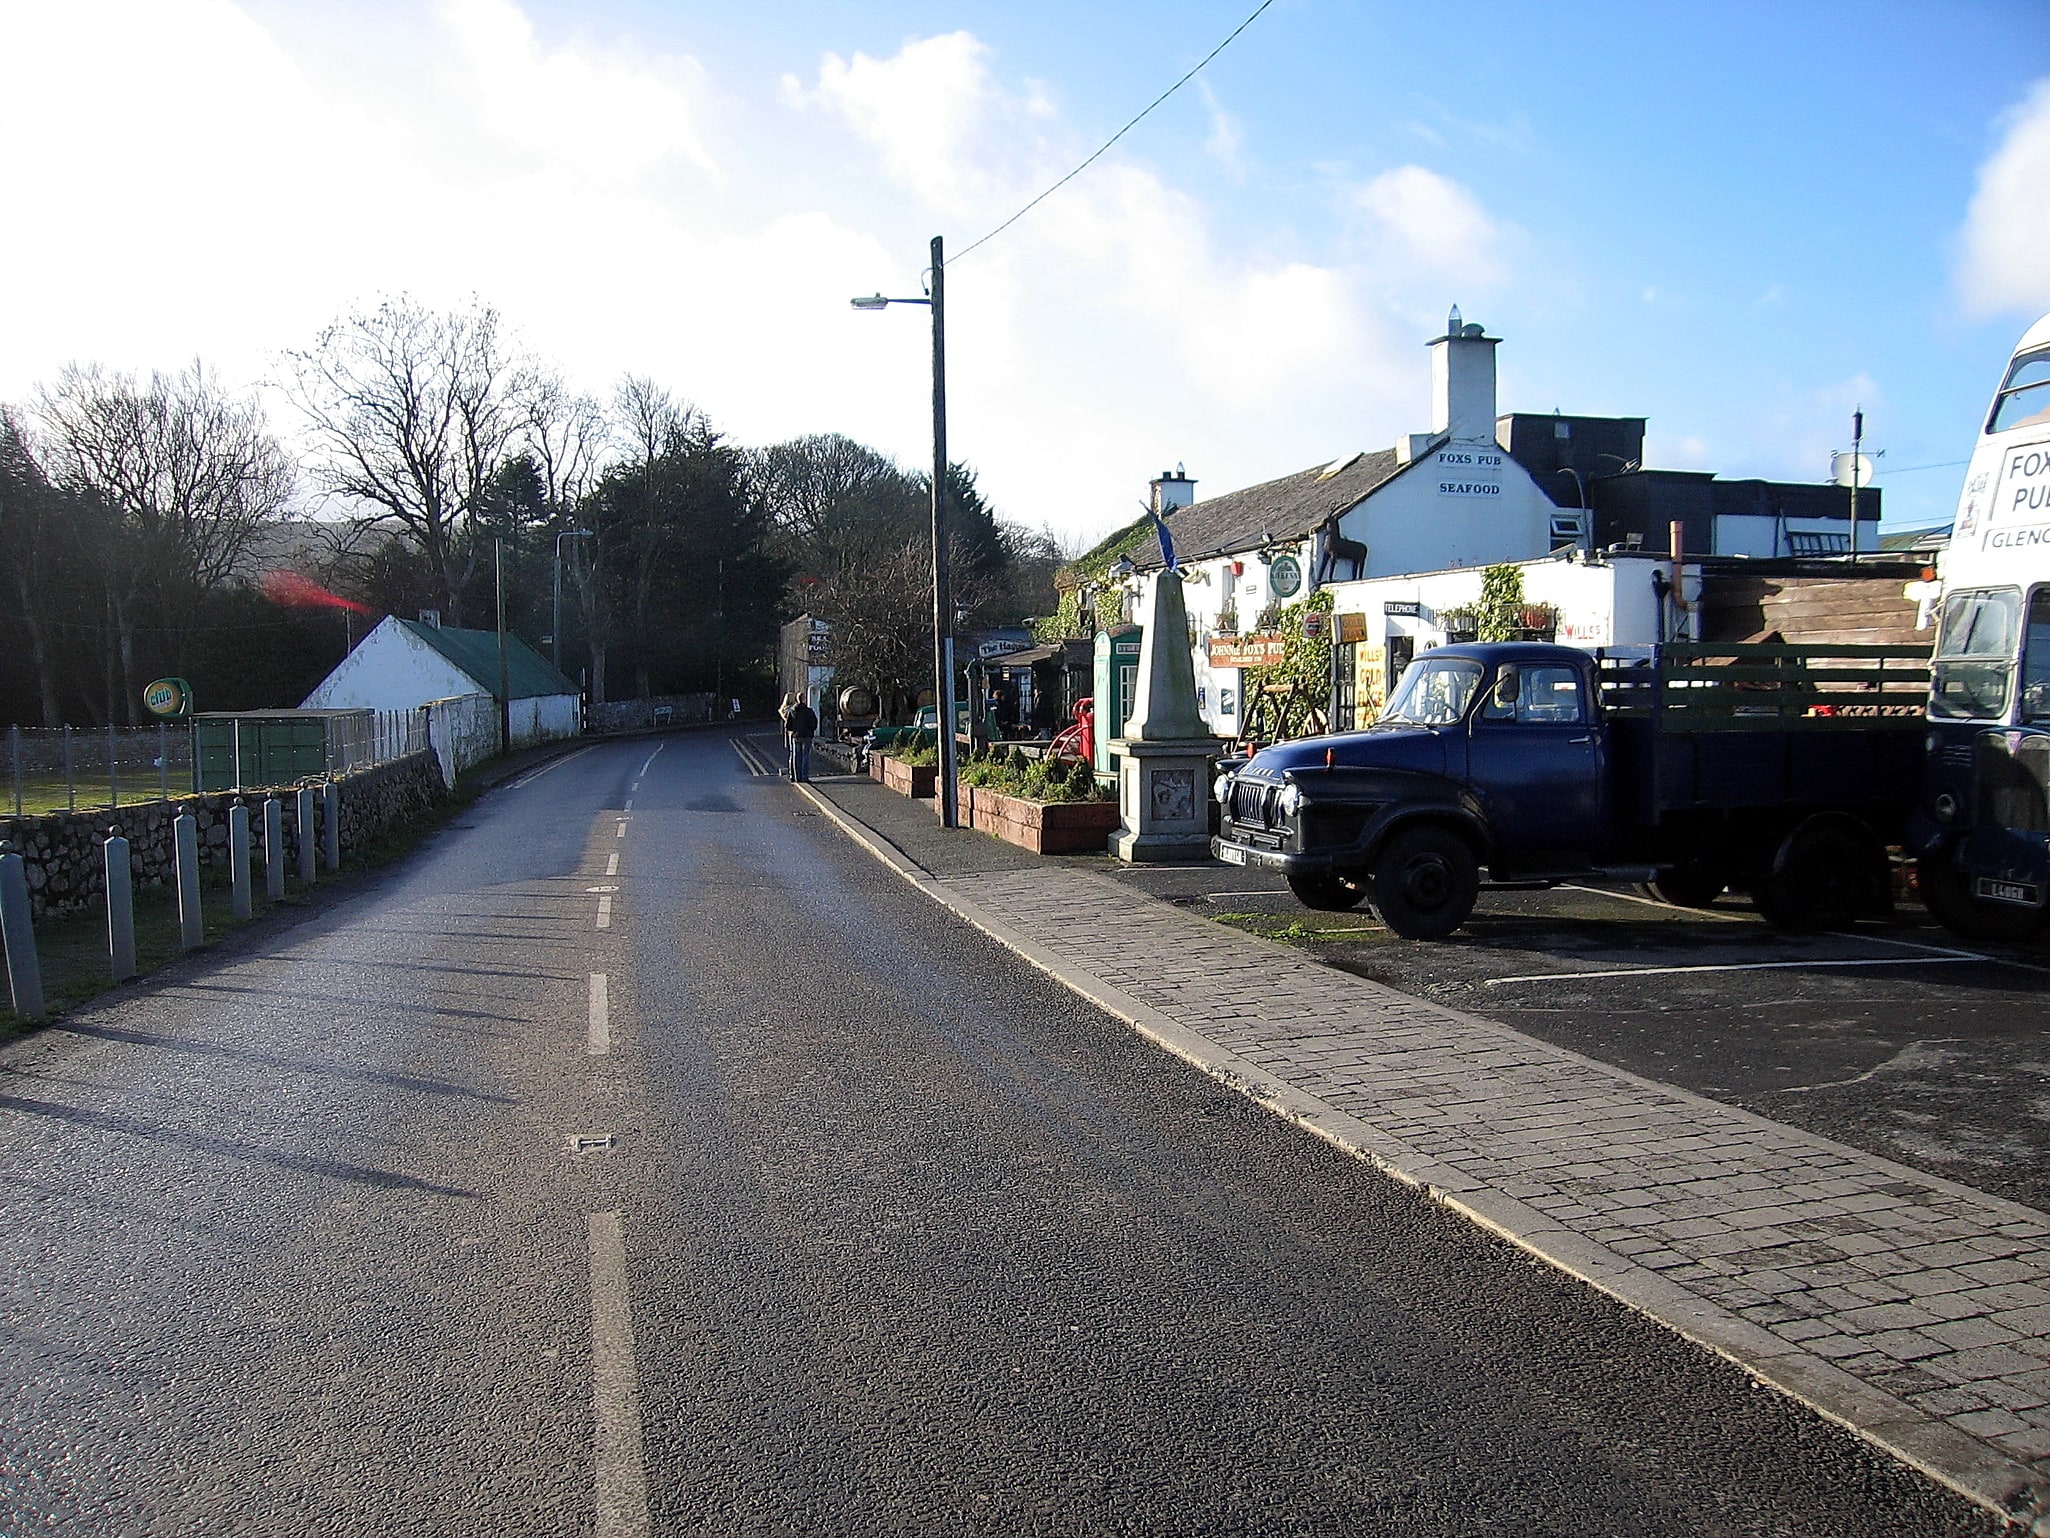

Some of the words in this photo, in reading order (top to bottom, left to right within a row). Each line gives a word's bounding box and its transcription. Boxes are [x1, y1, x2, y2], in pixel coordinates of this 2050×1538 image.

[1439, 453, 1472, 464] FOXS
[1477, 455, 1502, 465] PUB
[1439, 483, 1500, 494] SEAFOOD
[1385, 603, 1418, 613] TELEPHONE
